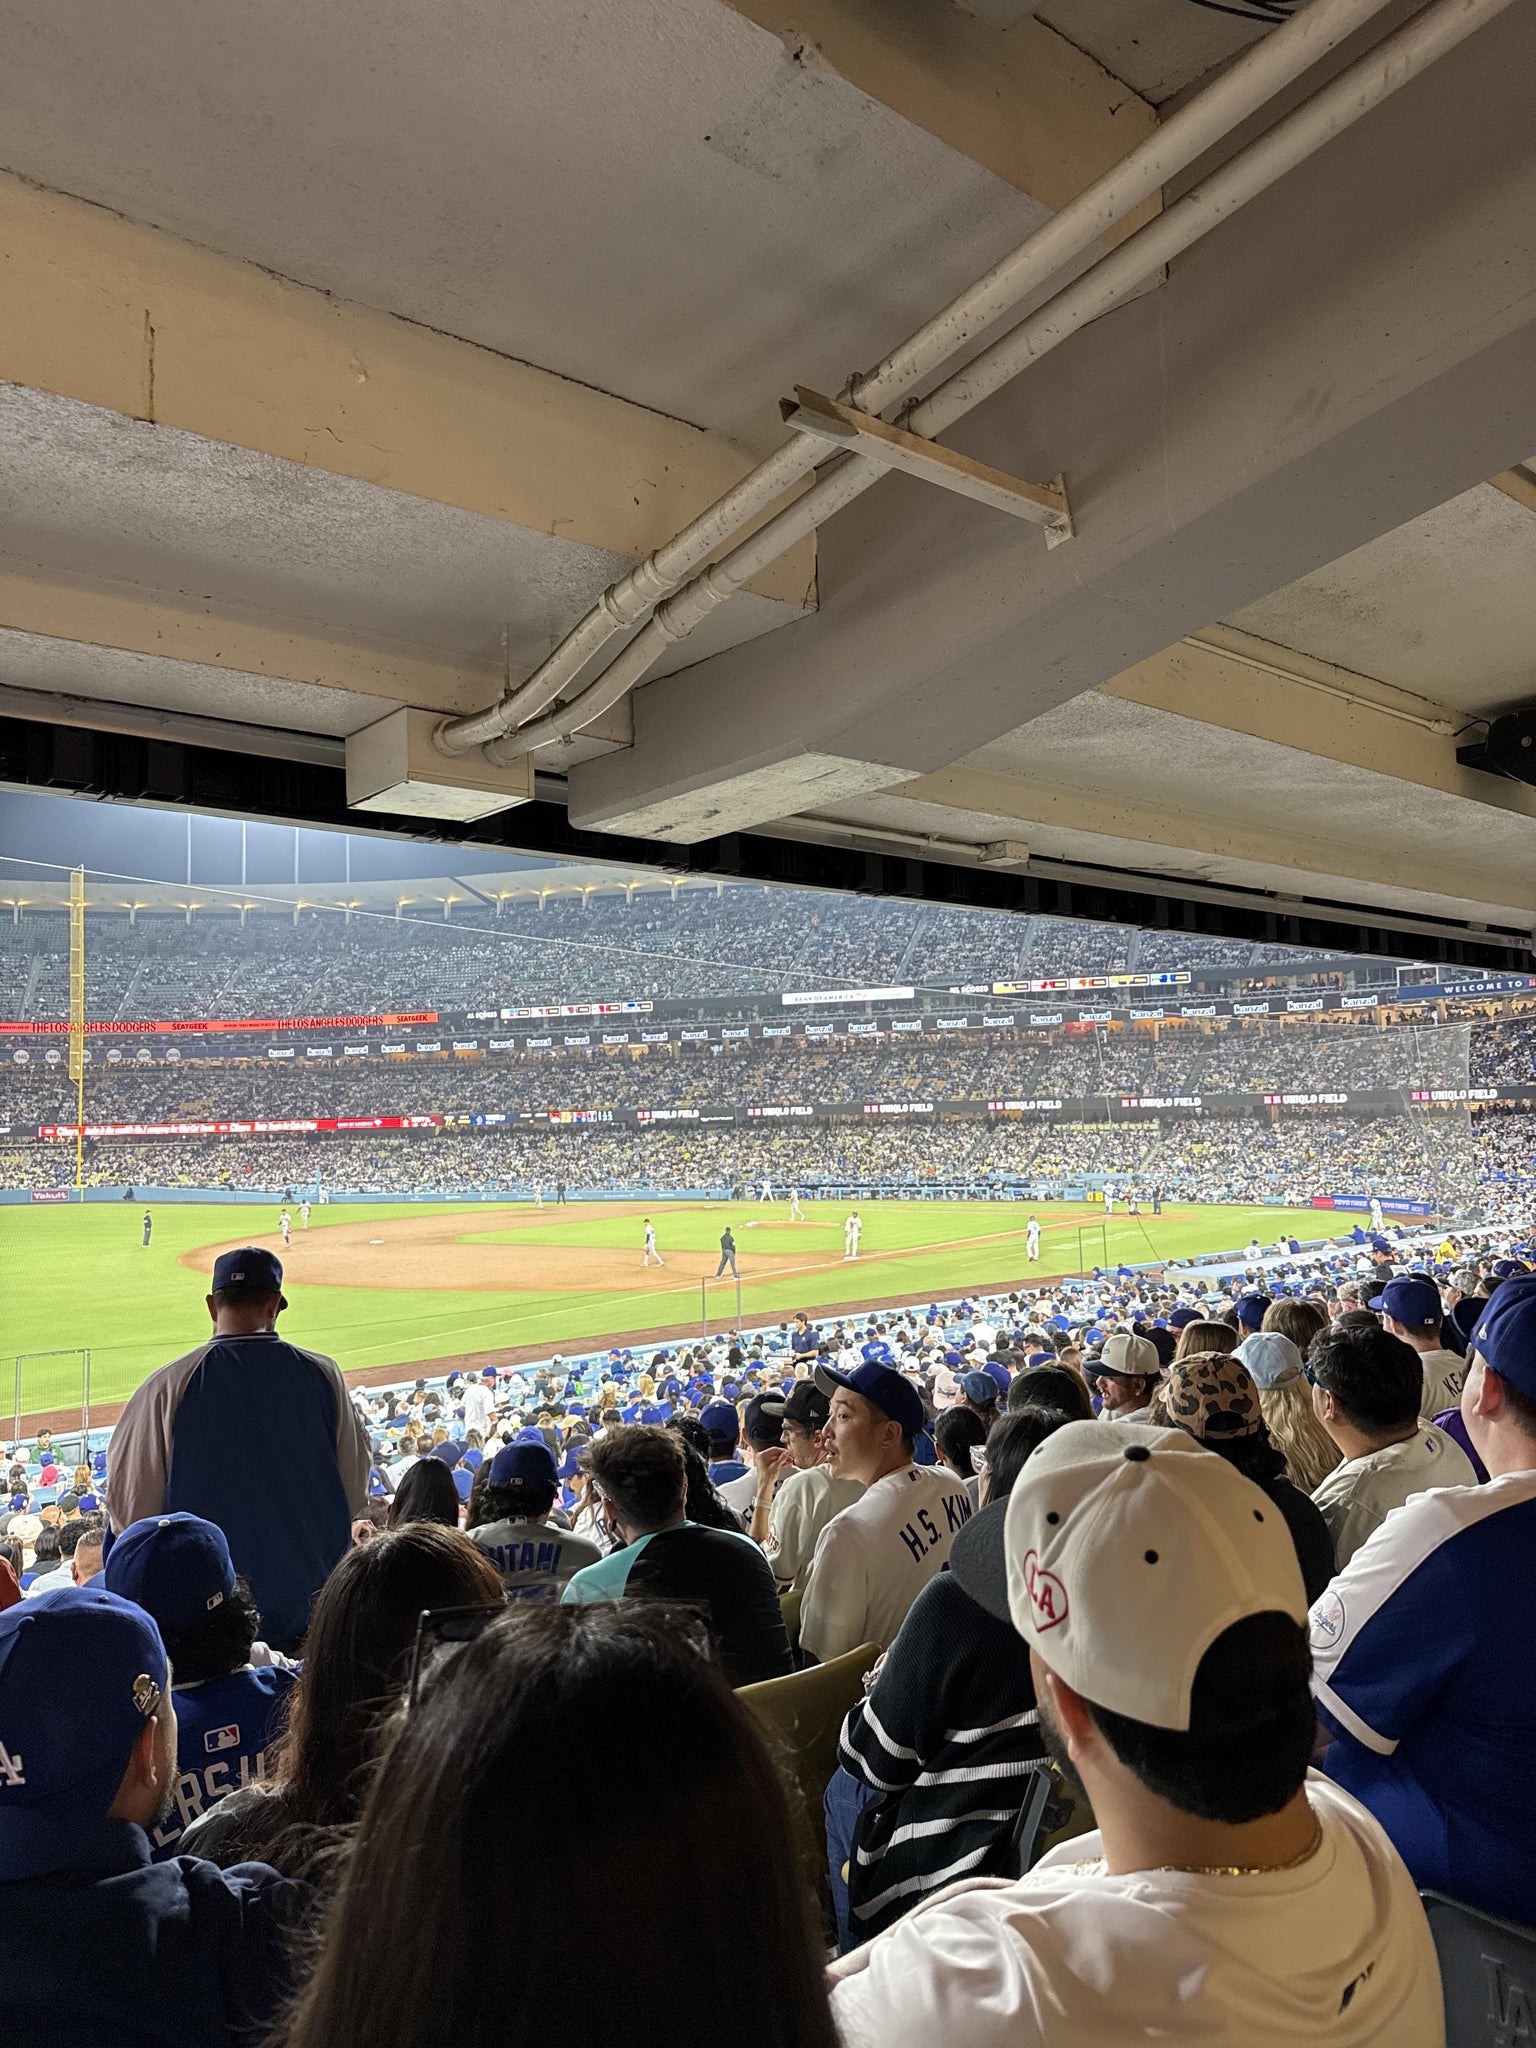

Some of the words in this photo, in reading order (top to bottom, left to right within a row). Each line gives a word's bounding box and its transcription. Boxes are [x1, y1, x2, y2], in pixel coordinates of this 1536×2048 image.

[1444, 982, 1502, 994] WELCOME
[1508, 980, 1523, 988] TO
[277, 1020, 292, 1029] THE
[292, 1019, 309, 1028] LOS
[310, 1017, 345, 1028] ANGELES
[346, 1016, 383, 1027] DODGERS
[396, 1014, 428, 1023] SEATGEEK
[32, 1023, 49, 1033] THE
[51, 1023, 68, 1033] LOS
[112, 1022, 156, 1032] DODGERS
[1283, 1095, 1317, 1105] UNIQLO
[1318, 1094, 1348, 1103] FIELD
[1431, 1090, 1466, 1100] UNIQLO
[1468, 1089, 1498, 1099] FIELD
[909, 1103, 934, 1112] FIELD
[1037, 1100, 1062, 1109] FIELD
[1174, 1097, 1202, 1107] FIELD
[32, 1190, 68, 1200] Yakult
[1443, 1371, 1464, 1397] KE
[899, 1508, 942, 1563] H.S.
[941, 1494, 973, 1533] KIM
